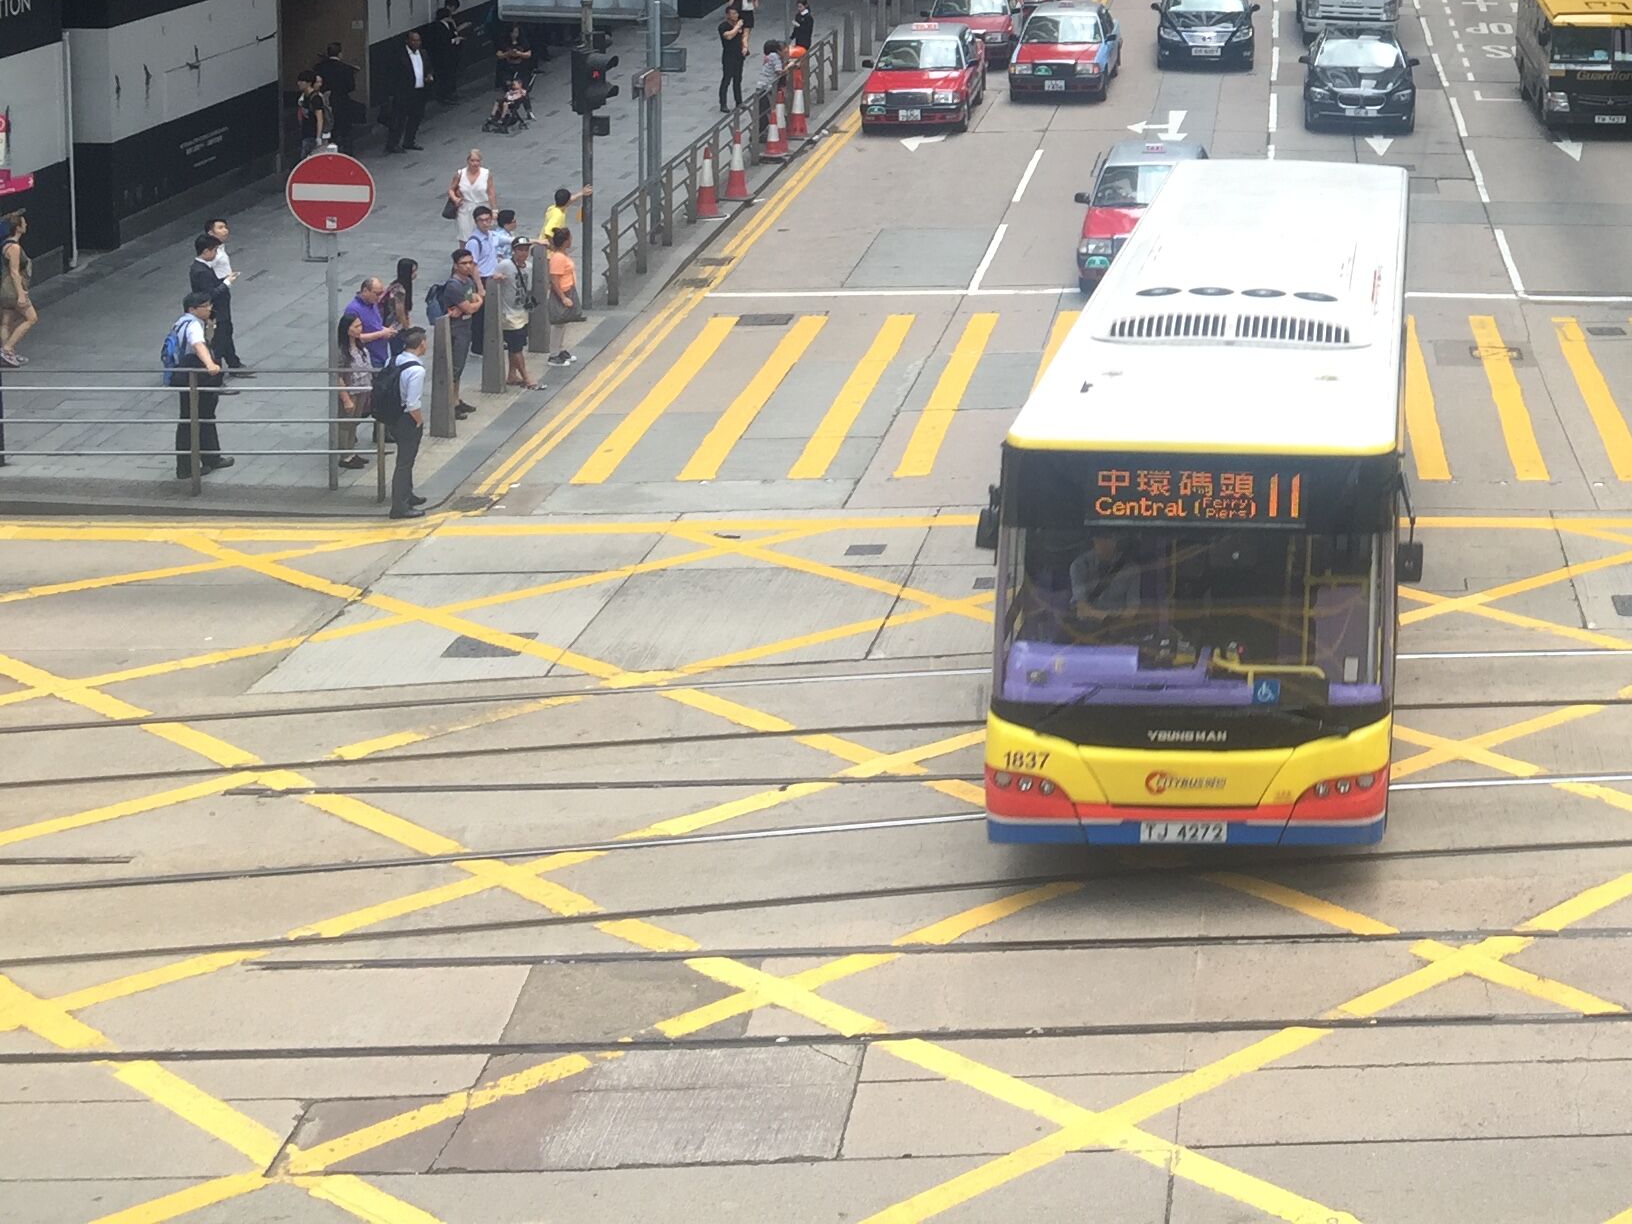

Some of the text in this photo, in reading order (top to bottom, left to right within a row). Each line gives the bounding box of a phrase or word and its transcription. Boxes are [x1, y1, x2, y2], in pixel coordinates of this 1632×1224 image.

[1098, 469, 1254, 497] 中環碼頭
[1268, 473, 1299, 518] 11
[1095, 497, 1188, 517] Central
[1147, 730, 1228, 742] YOUNGMAN
[1003, 751, 1050, 770] 1837
[1145, 826, 1224, 842] TJ 4272
